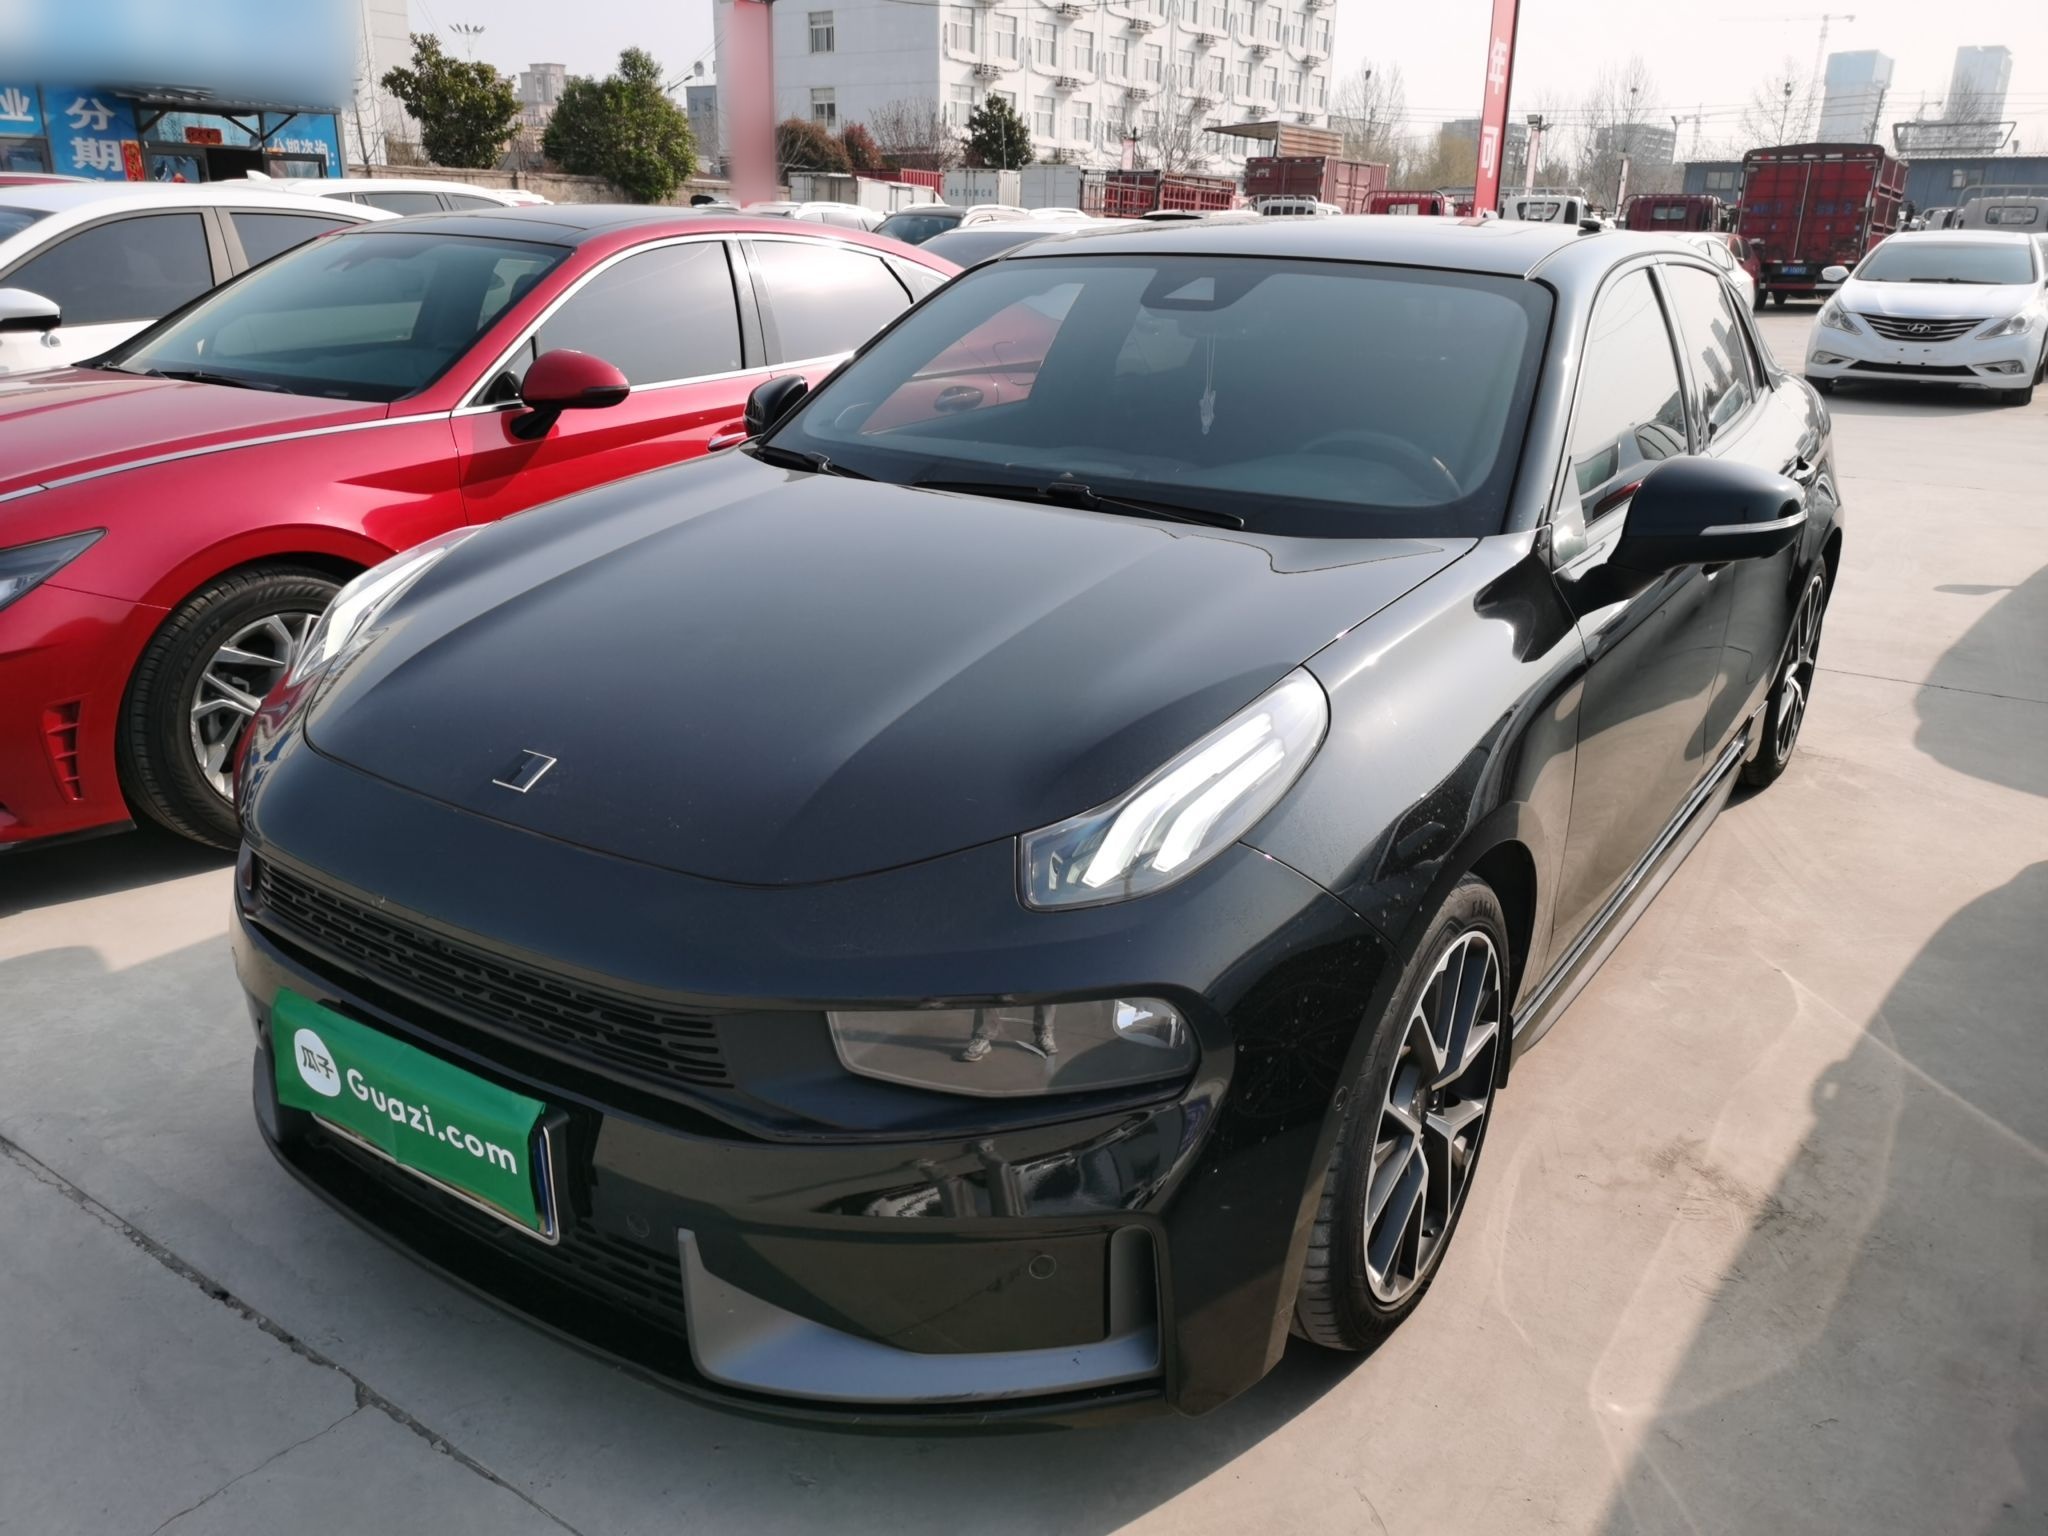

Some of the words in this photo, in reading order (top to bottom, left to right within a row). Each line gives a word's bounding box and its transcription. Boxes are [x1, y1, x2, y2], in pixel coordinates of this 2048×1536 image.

[65, 97, 123, 181] 分期
[300, 1044, 335, 1080] 瓜子
[346, 1068, 518, 1176] Guazi.com
